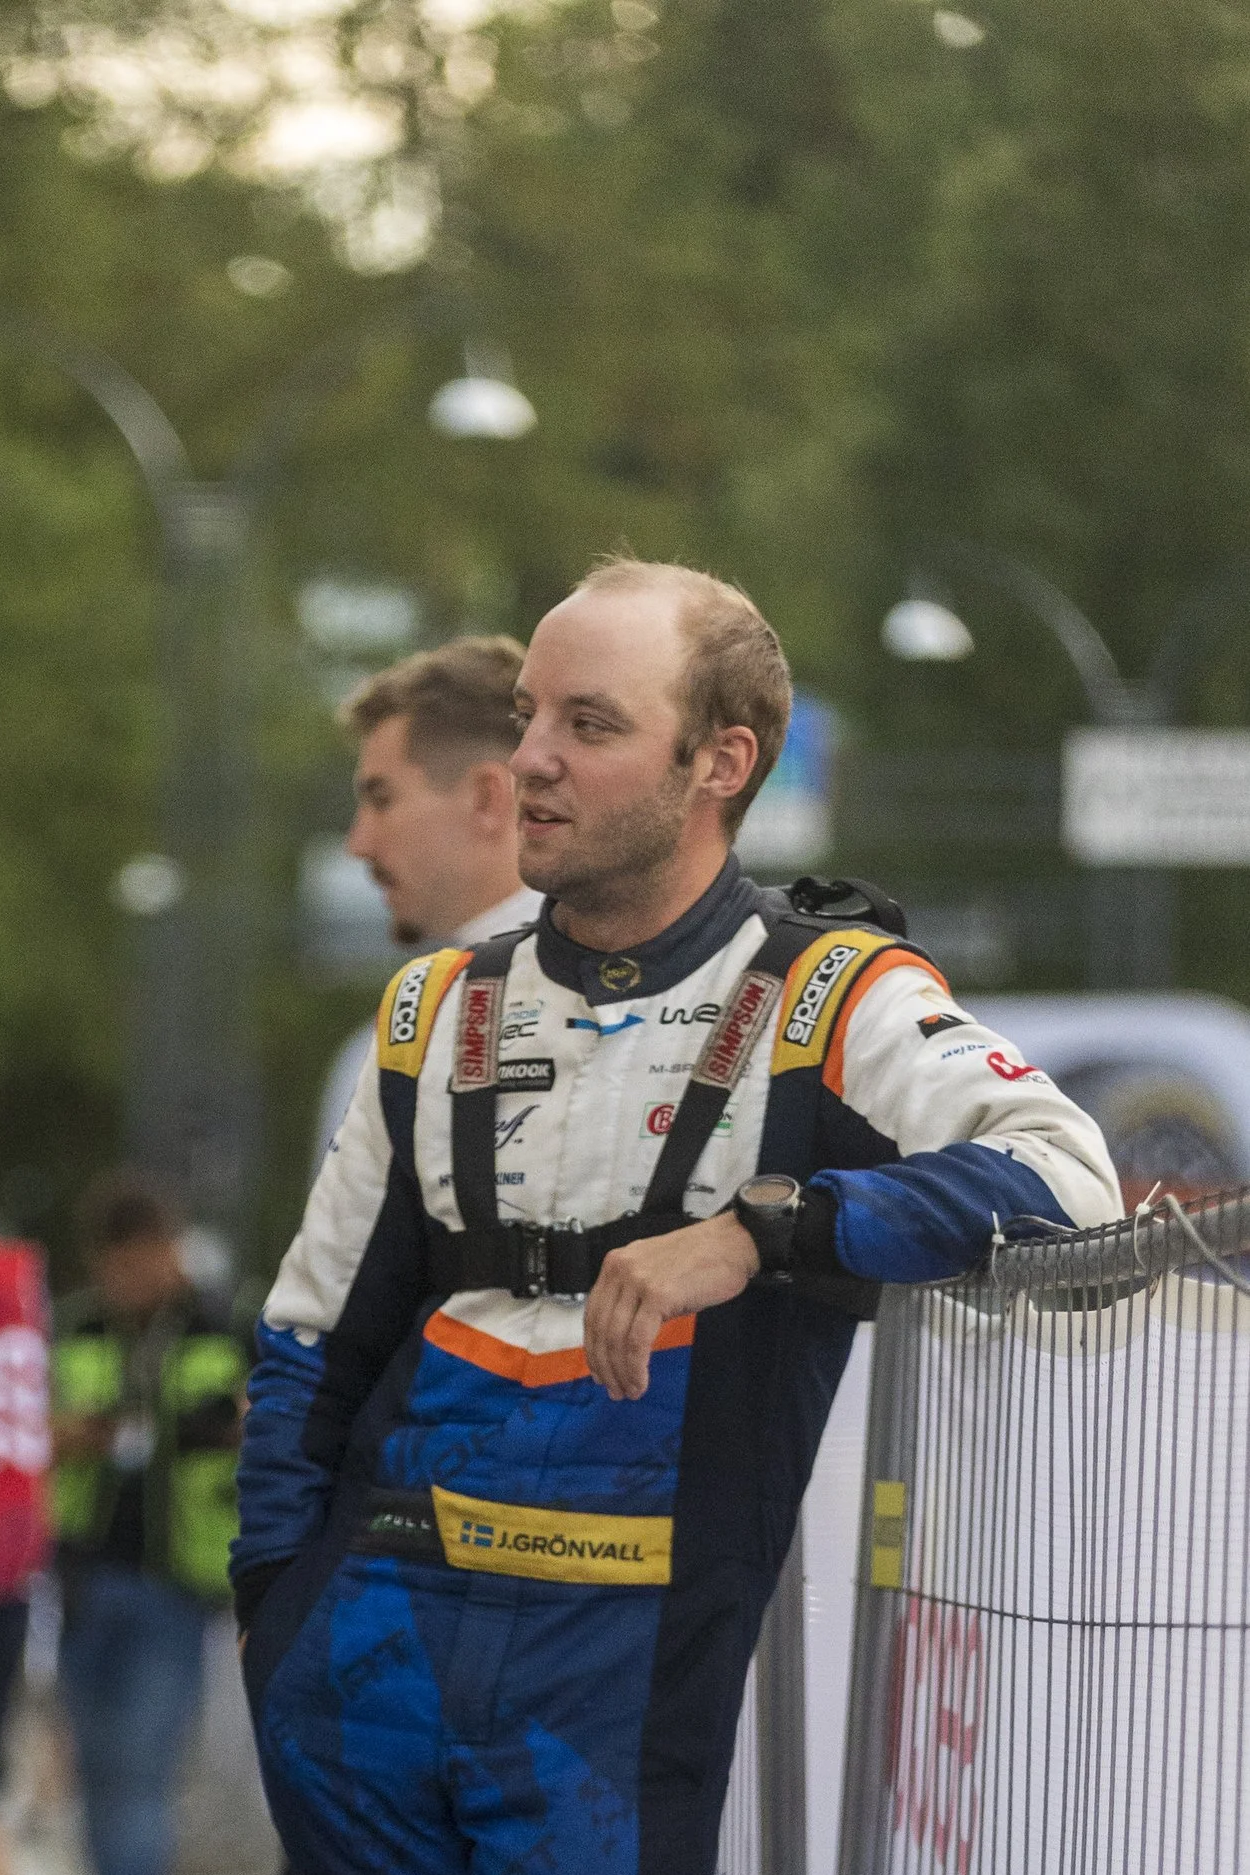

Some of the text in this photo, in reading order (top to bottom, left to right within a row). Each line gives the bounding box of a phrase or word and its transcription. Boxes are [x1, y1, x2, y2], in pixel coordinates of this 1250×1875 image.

[464, 989, 490, 1077] SIMPSON
[709, 982, 765, 1077] SIMPSON
[786, 946, 859, 1045] sparco
[496, 1531, 645, 1562] J.GRÖNVALL
